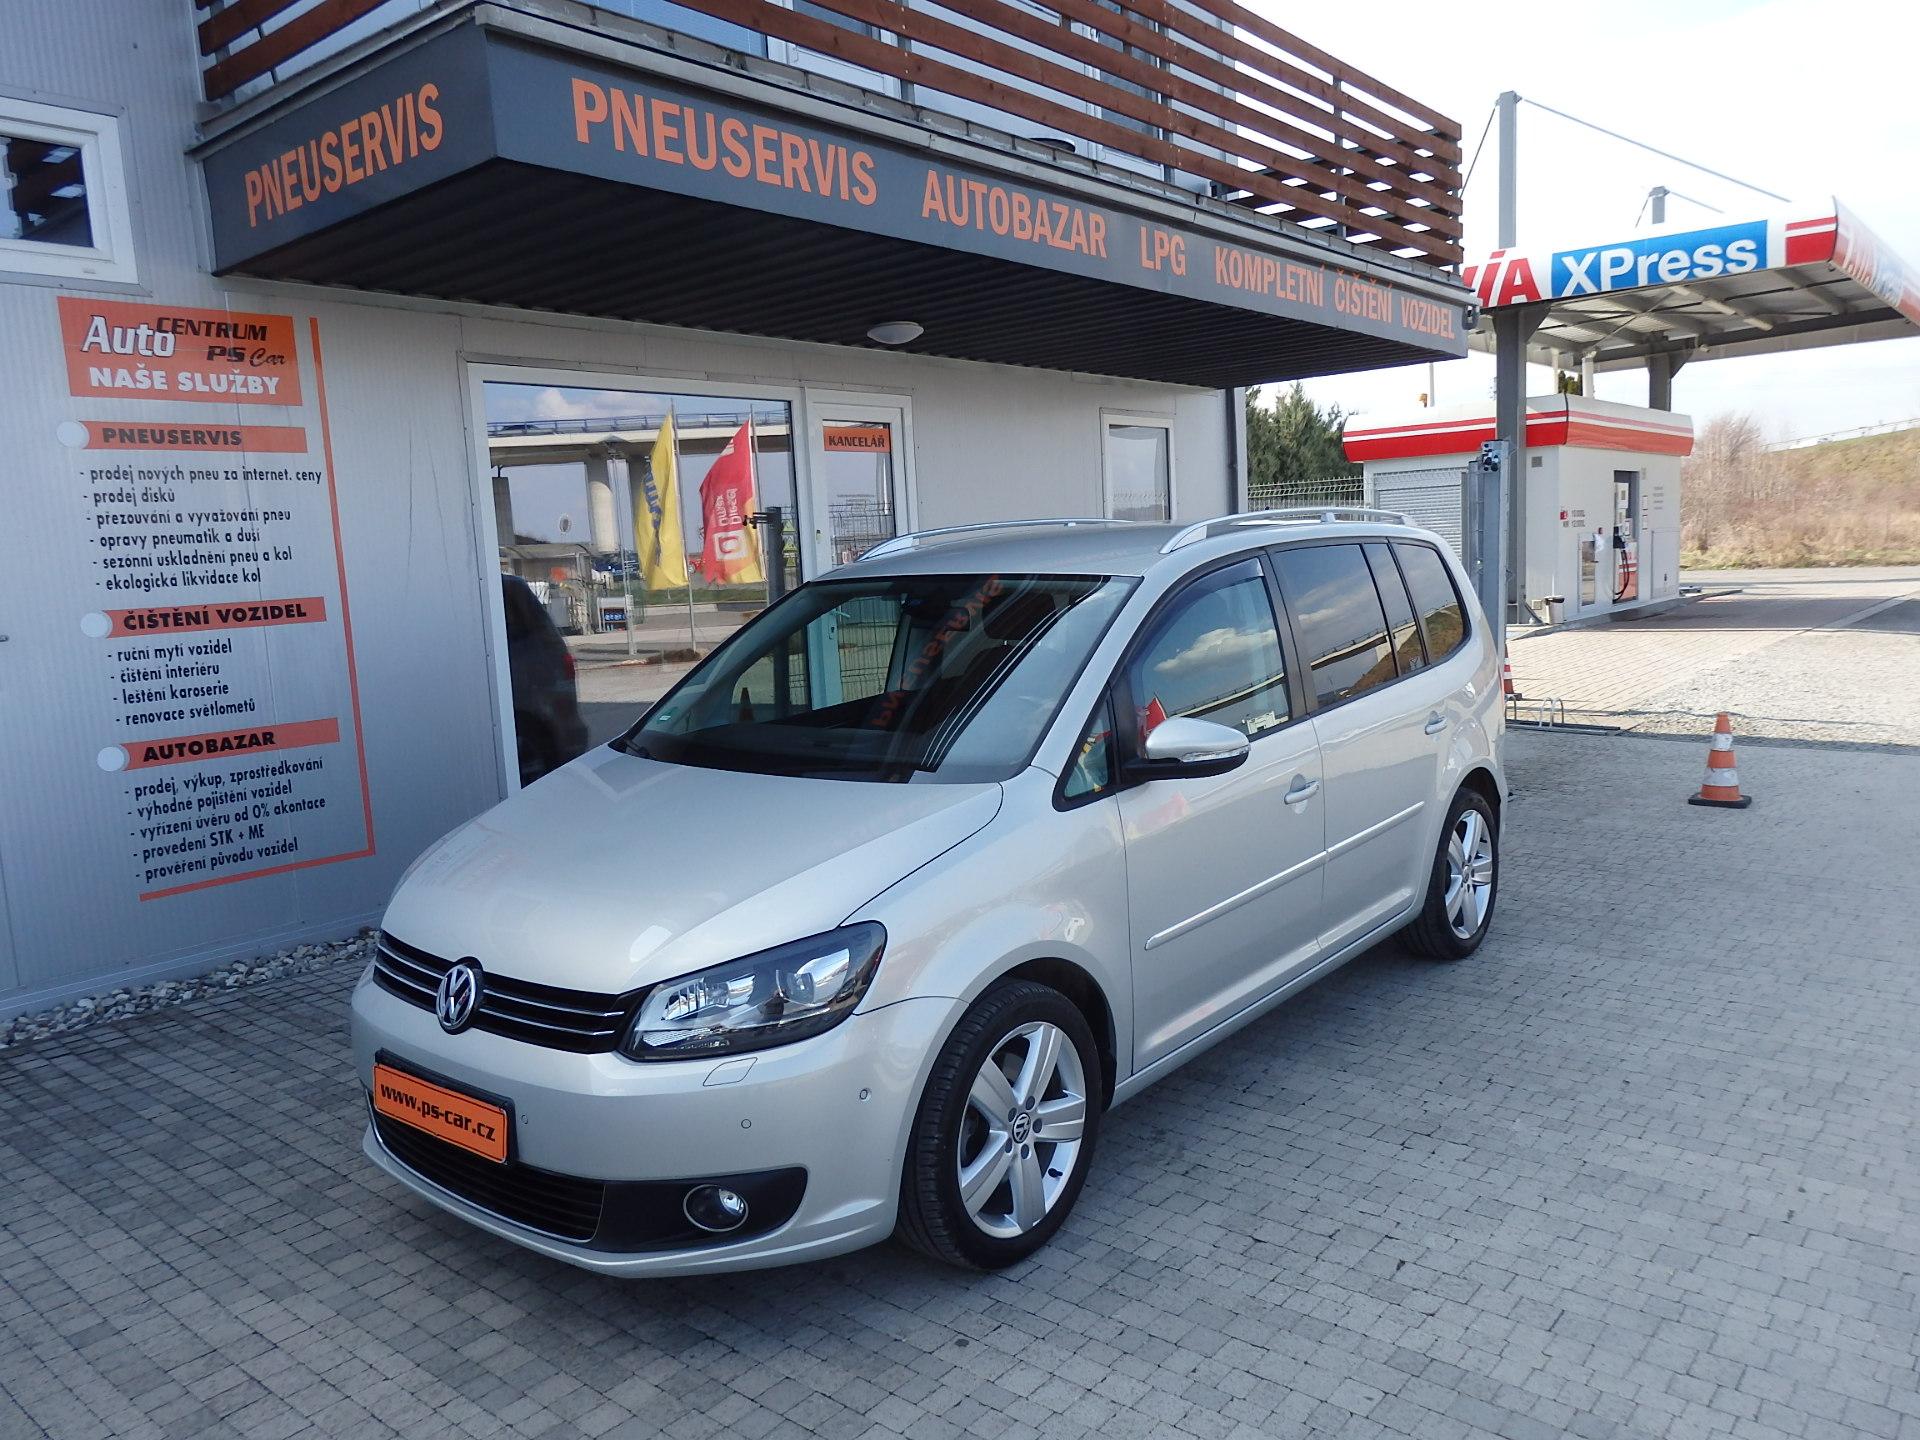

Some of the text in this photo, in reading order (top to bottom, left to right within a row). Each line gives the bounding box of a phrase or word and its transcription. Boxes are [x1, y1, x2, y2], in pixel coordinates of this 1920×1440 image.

[243, 82, 443, 228] PNEUSERVIS
[571, 77, 878, 206] PNEUSERVIS
[921, 169, 1107, 259] AUTOBAZAR
[1140, 226, 1187, 276] LPG
[1560, 237, 1759, 298] XPress
[1214, 245, 1455, 340] KOMPLETNÍ ČIŠTĚNÍ VOZIDEL
[81, 314, 176, 357] Auto
[156, 316, 268, 341] CENTRUM
[206, 345, 286, 367] PS Car
[89, 362, 280, 395] NAŠE SLUŽBY
[102, 427, 242, 446] PNEUSERVIS
[827, 433, 886, 449] KANCELÁŘ
[90, 464, 322, 485] prodej nových pneu za internet. ceny
[93, 486, 175, 508] prodej disků
[96, 507, 291, 530] přezouvání a vyvažování pneu
[100, 535, 147, 551] opravy
[152, 527, 220, 549] pneumatik
[224, 532, 232, 543] a
[103, 545, 293, 569] sezónní uskladnění pneu a kol
[106, 567, 262, 593] ekologická likvidace kol
[123, 603, 308, 631] ČIŠTĚNÍ VOZIDEL
[117, 645, 151, 662] ruční
[188, 637, 233, 656] vozidel
[120, 661, 220, 684] čištění interiéru
[122, 680, 230, 705] leštění karoserie
[125, 698, 256, 726] renovace světlometů
[143, 731, 276, 763] AUTOBAZAR
[134, 756, 324, 802] prodej, výkup, zprostředkování
[137, 779, 293, 821] výhodné pojištění vozidel
[139, 797, 327, 842] vyřízení úvěru od 0% akontace
[142, 836, 207, 864] provedení
[209, 828, 235, 847] STK
[248, 823, 266, 841] ME
[145, 836, 300, 884] prověření původu vozidel
[380, 1083, 496, 1143] www.ps-car.cz
